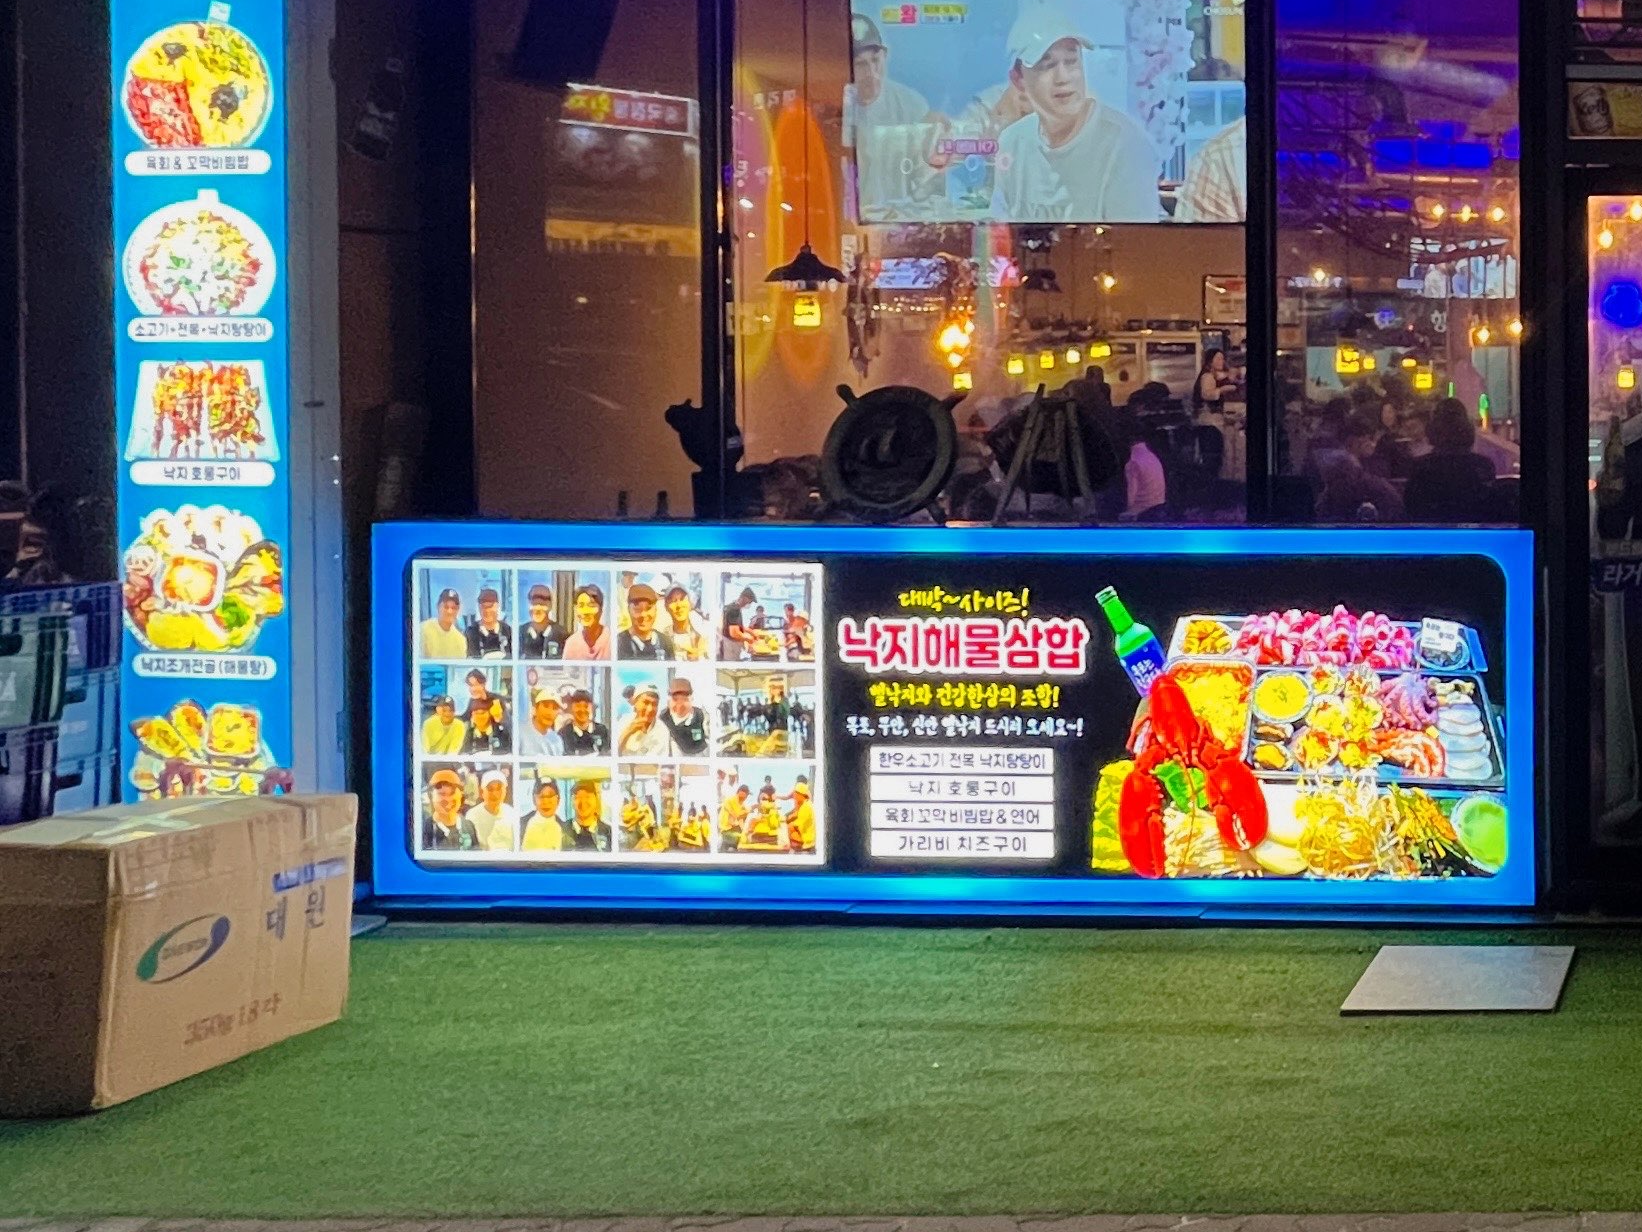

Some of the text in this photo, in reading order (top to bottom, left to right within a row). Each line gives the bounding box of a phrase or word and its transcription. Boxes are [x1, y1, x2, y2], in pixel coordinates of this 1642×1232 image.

[163, 466, 188, 481] 낙지
[841, 620, 1087, 671] 낙지해물삼합
[878, 752, 1046, 770] 한우소고기 전복 낙지탕탕이
[908, 781, 941, 796] 낙지
[898, 835, 1027, 853] 가리비 치즈구이
